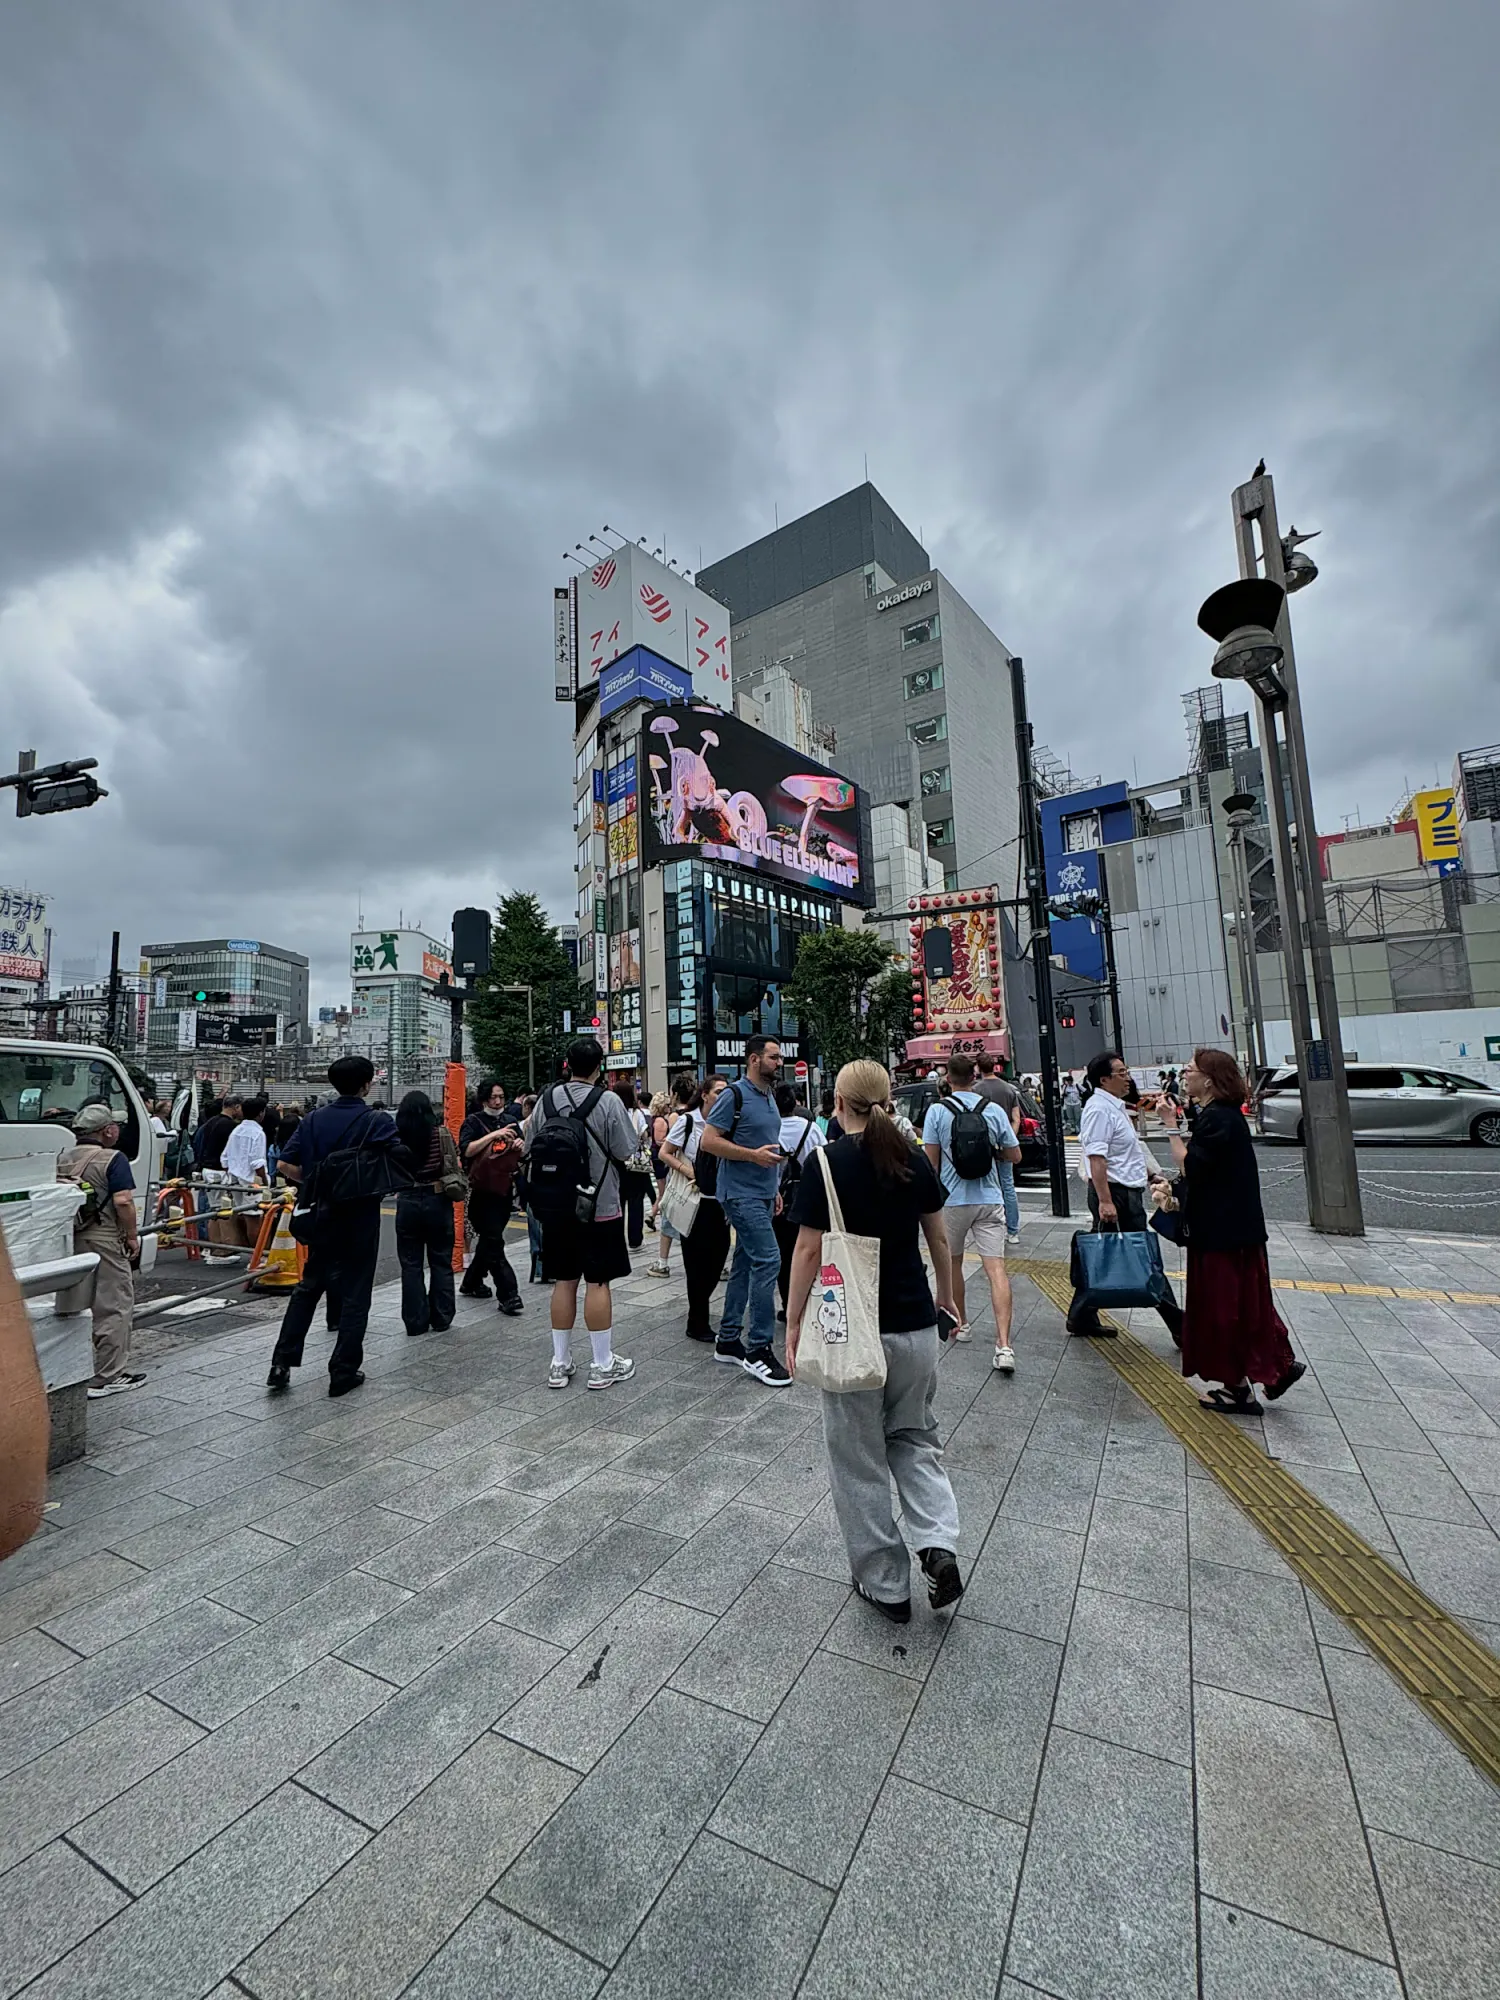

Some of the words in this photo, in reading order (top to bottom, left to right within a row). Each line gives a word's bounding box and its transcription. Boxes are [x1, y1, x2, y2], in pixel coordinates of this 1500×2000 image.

[877, 580, 932, 611] okadaya
[650, 670, 685, 696] アパマンショップ
[1068, 817, 1100, 853] 靴
[738, 827, 782, 864] BLUE
[783, 843, 860, 889] ELEPHANT
[676, 859, 694, 926] BLUE
[704, 871, 753, 900] BLUE
[755, 888, 832, 921] ELEPHANT
[0, 892, 45, 922] カラオケ
[16, 919, 26, 933] の
[0, 931, 37, 956] 鉄人
[230, 942, 258, 951] welcia
[355, 945, 372, 956] TA
[611, 944, 620, 953] Dr
[622, 937, 640, 950] Foot
[354, 955, 373, 966] NO
[679, 927, 697, 1060] ELEPHANT
[943, 1005, 980, 1014] SHINJUKU
[716, 1039, 746, 1057] BLUE
[951, 1038, 986, 1056] 屋台苑
